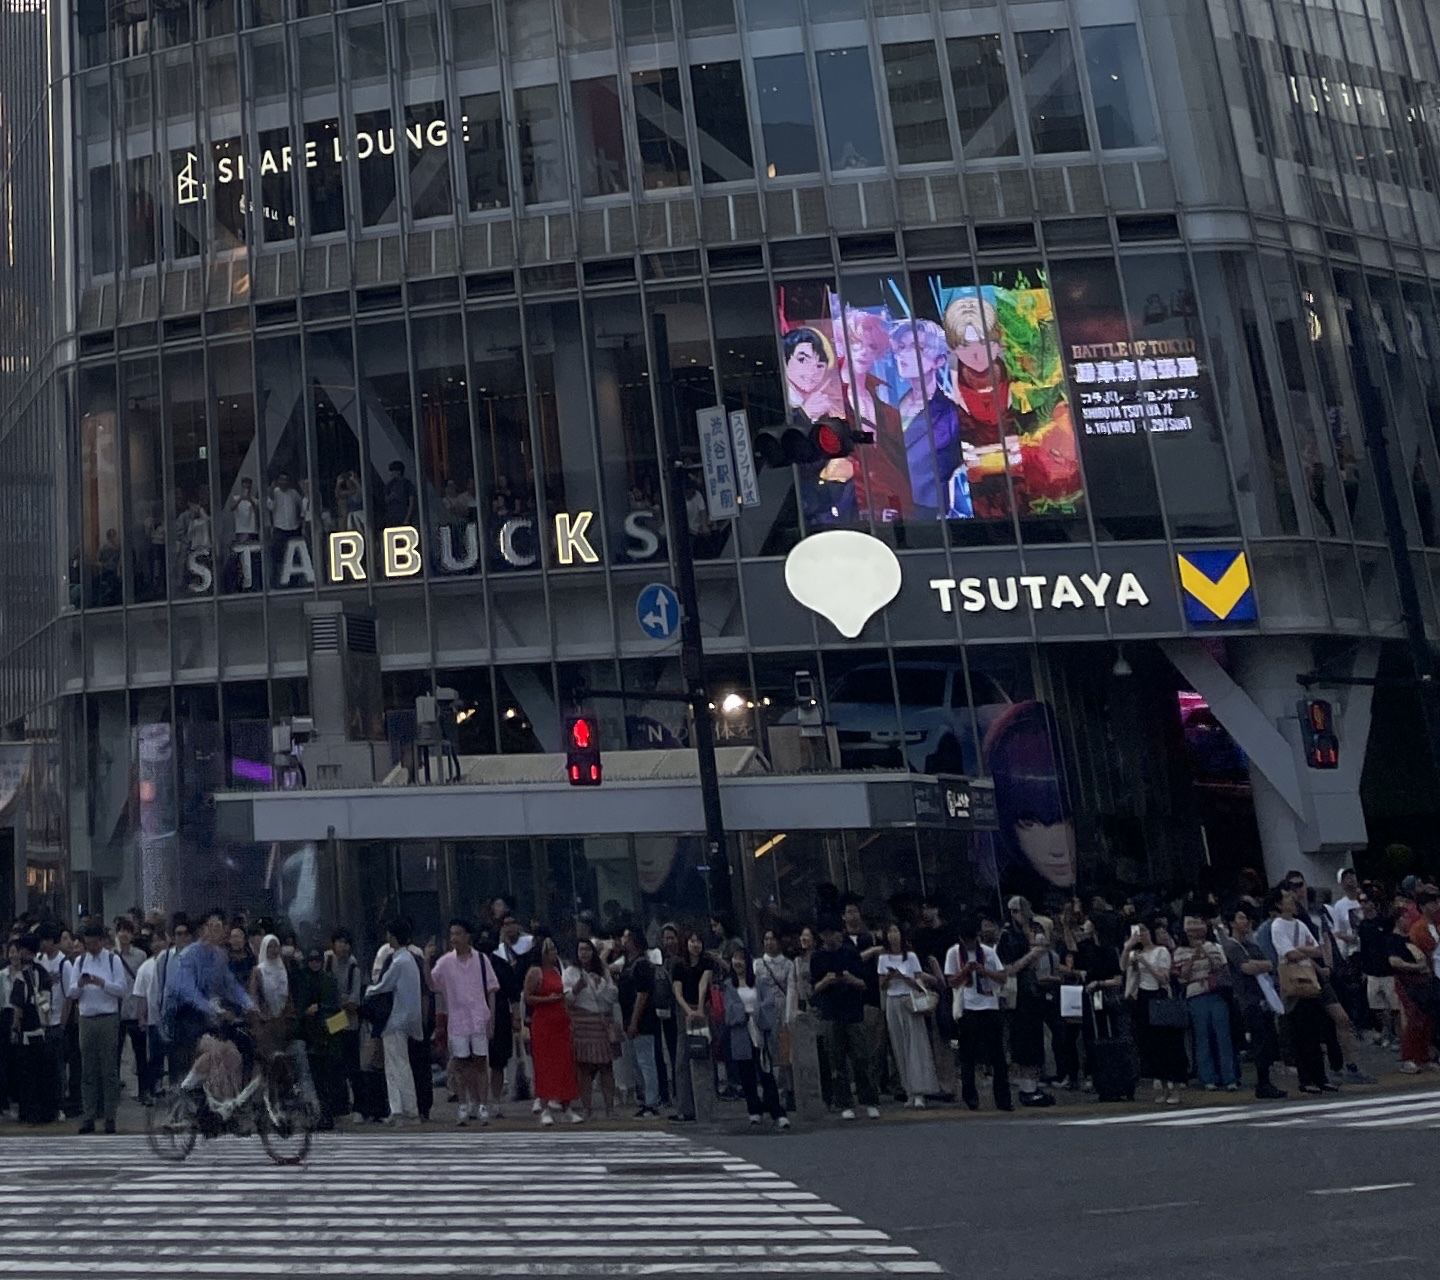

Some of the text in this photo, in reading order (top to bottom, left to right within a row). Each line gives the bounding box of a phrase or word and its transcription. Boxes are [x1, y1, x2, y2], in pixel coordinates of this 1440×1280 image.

[217, 141, 318, 184] SARE
[1071, 342, 1129, 359] BATTLE
[711, 416, 734, 510] 渋谷駅前
[733, 415, 757, 504] スクランブル式
[186, 511, 661, 594] STARBUCKS
[930, 572, 1150, 614] TSUTAYA
